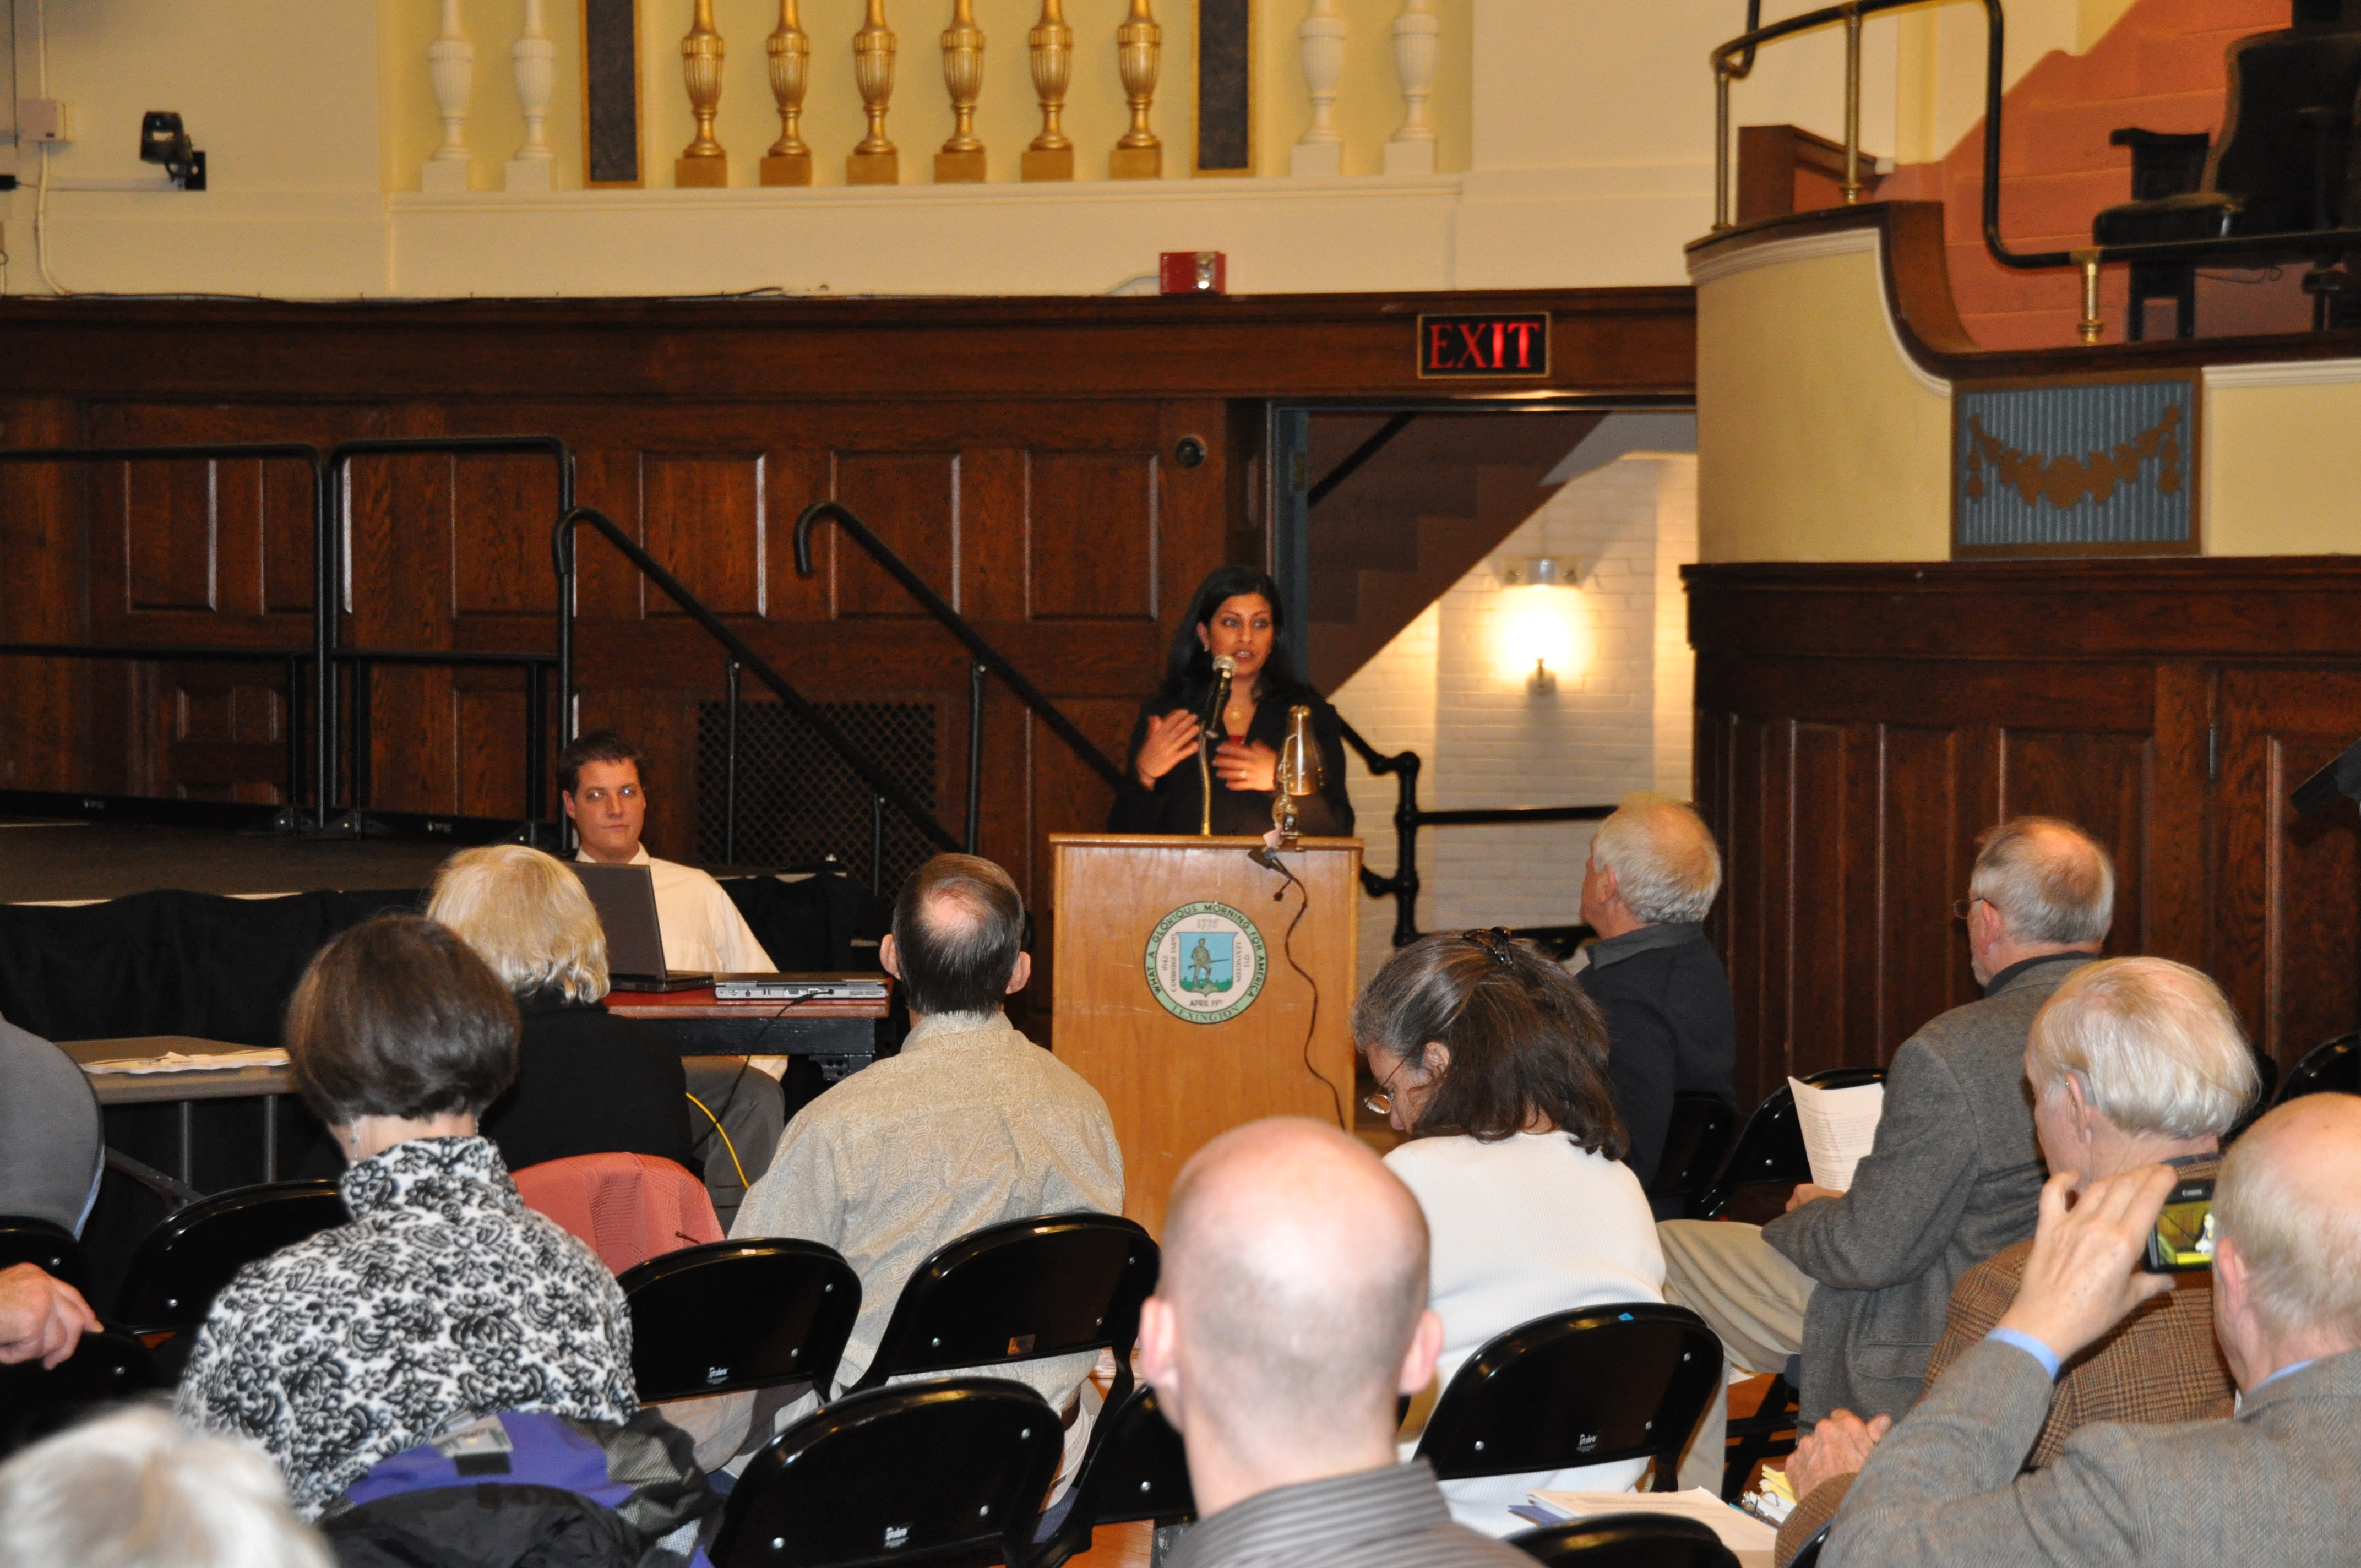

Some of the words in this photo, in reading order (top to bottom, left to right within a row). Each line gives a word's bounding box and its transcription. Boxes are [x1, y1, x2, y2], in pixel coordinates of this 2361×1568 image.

[1428, 322, 1541, 369] EXIT
[1152, 906, 1196, 943] GLORIOUS
[1204, 905, 1250, 929] MORNING
[1250, 931, 1262, 950] FOR
[1147, 967, 1161, 994] WHAT
[1247, 955, 1265, 997] AMERICA
[1172, 1005, 1239, 1022] LEXINGTON
